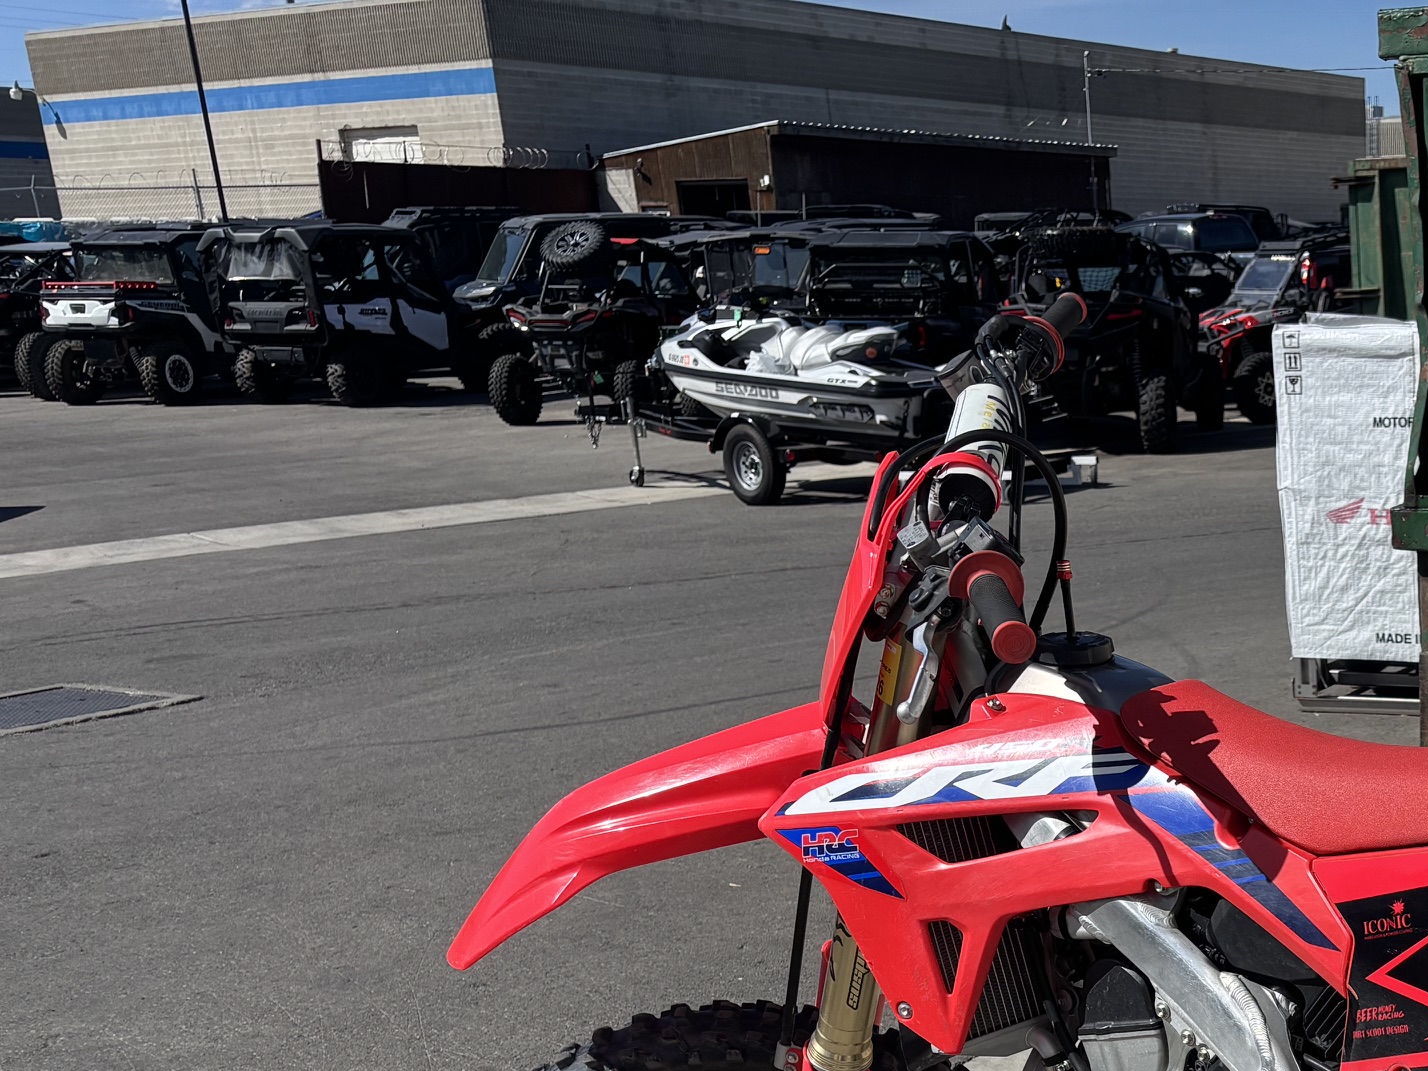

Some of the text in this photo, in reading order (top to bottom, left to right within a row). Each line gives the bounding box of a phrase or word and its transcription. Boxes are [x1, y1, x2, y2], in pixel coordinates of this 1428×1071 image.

[1375, 632, 1405, 645] MADE
[784, 754, 1141, 815] CRF
[802, 828, 859, 857] HRC
[830, 852, 860, 862] RACING
[1363, 913, 1412, 935] ICONIC
[1356, 1007, 1378, 1023] BEER
